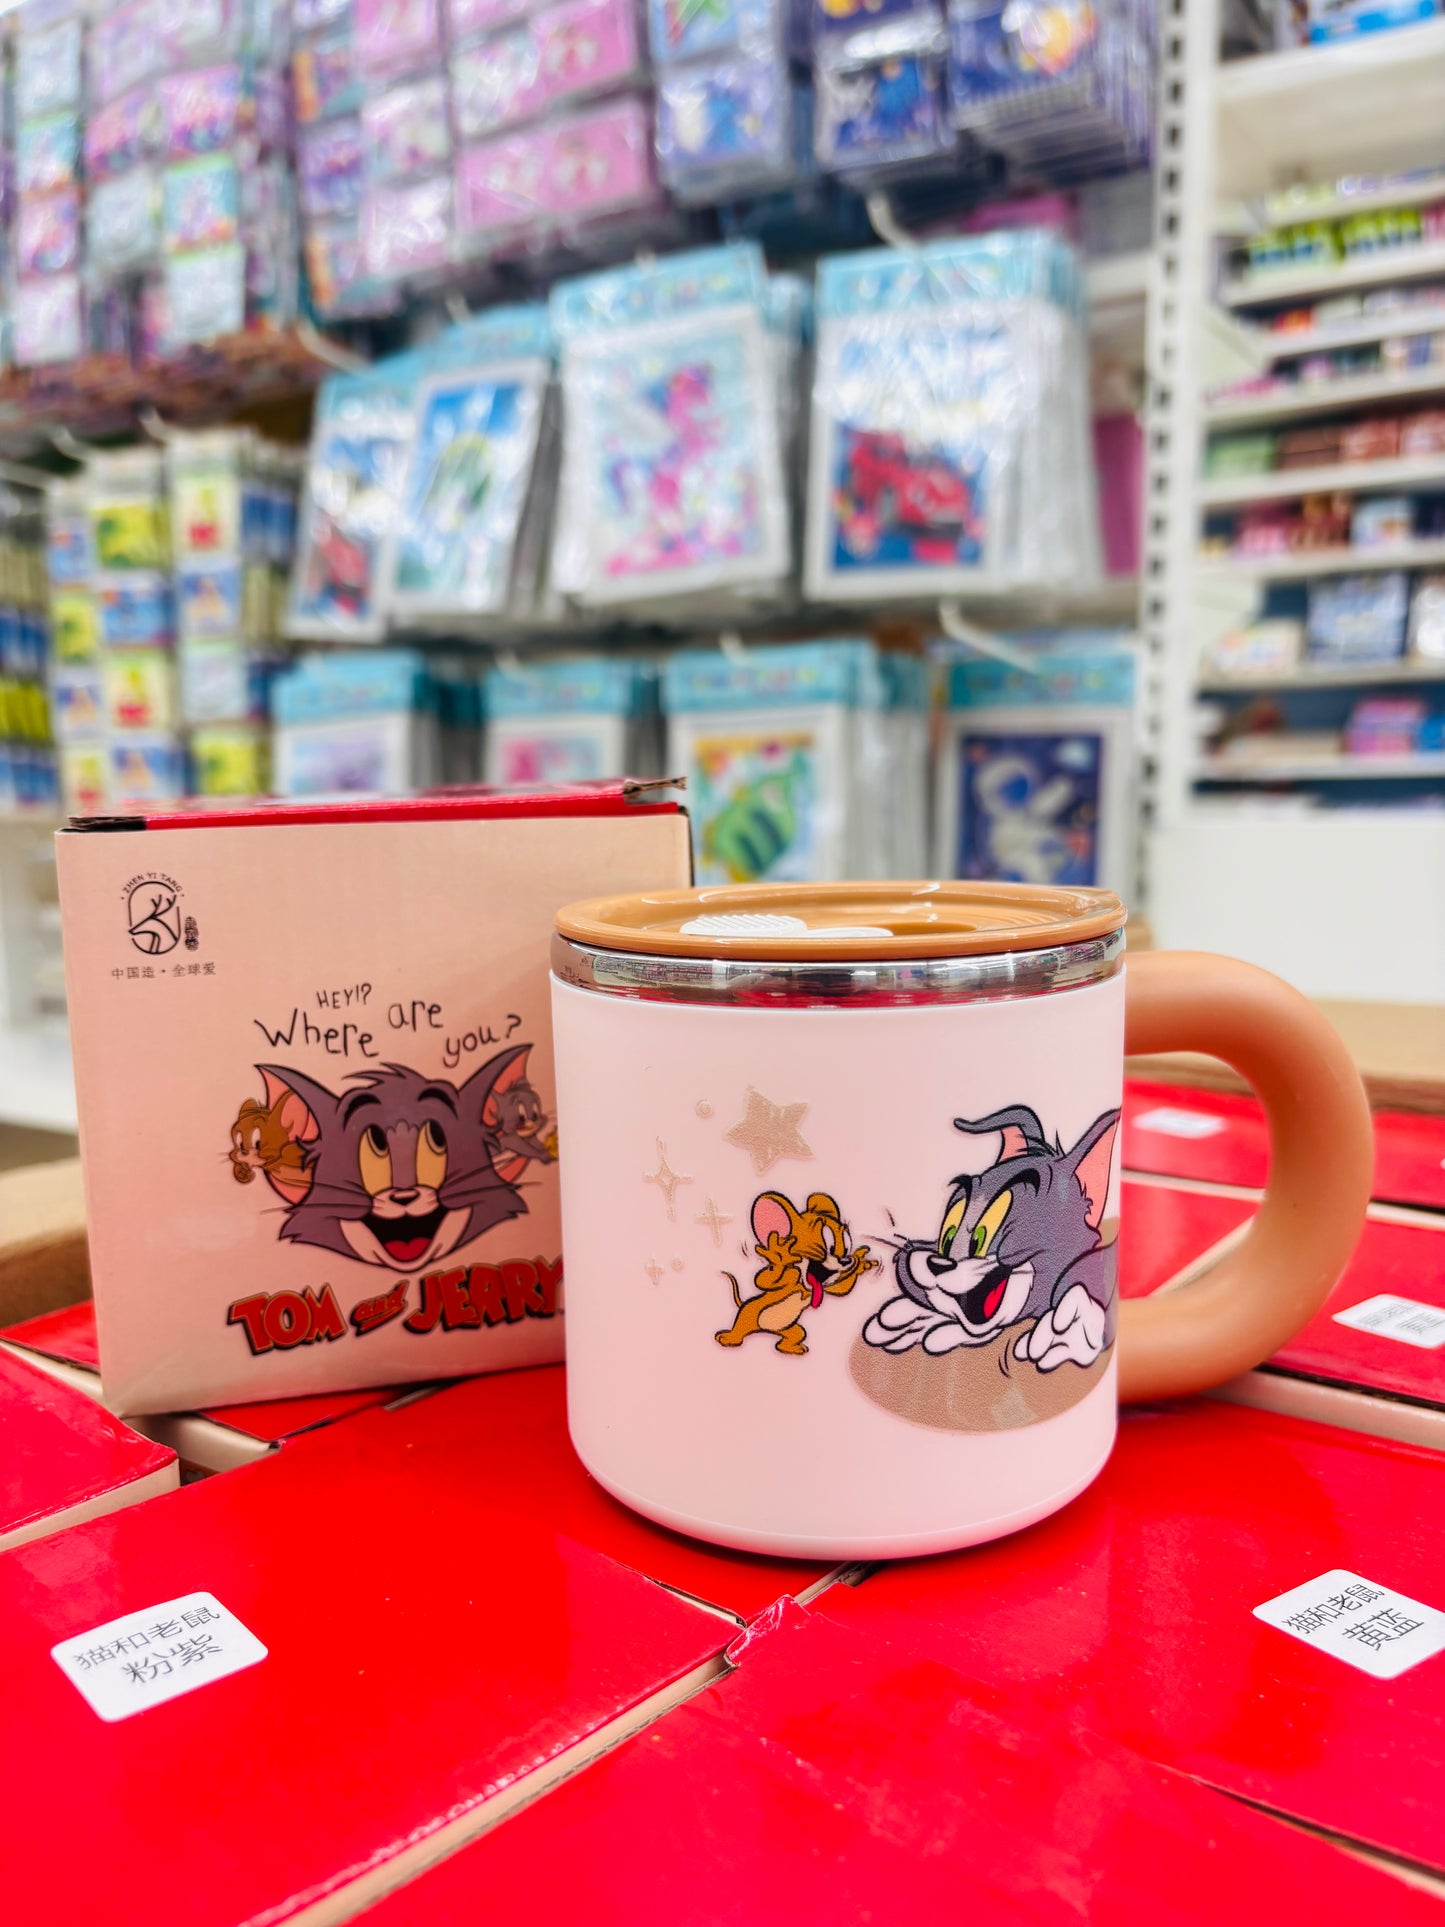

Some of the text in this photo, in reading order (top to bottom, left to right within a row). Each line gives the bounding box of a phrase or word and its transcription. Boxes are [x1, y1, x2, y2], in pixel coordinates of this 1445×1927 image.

[122, 874, 144, 893] ZHEN
[161, 873, 183, 892] TANG
[254, 1000, 522, 1068] Where are you?
[227, 1255, 564, 1355] TOM and JERRY
[1281, 1583, 1385, 1634] 猫和老鼠
[1342, 1608, 1425, 1651] 黄蓝
[74, 1606, 221, 1670] 猫和老鼠
[121, 1633, 223, 1684] 粉紫
